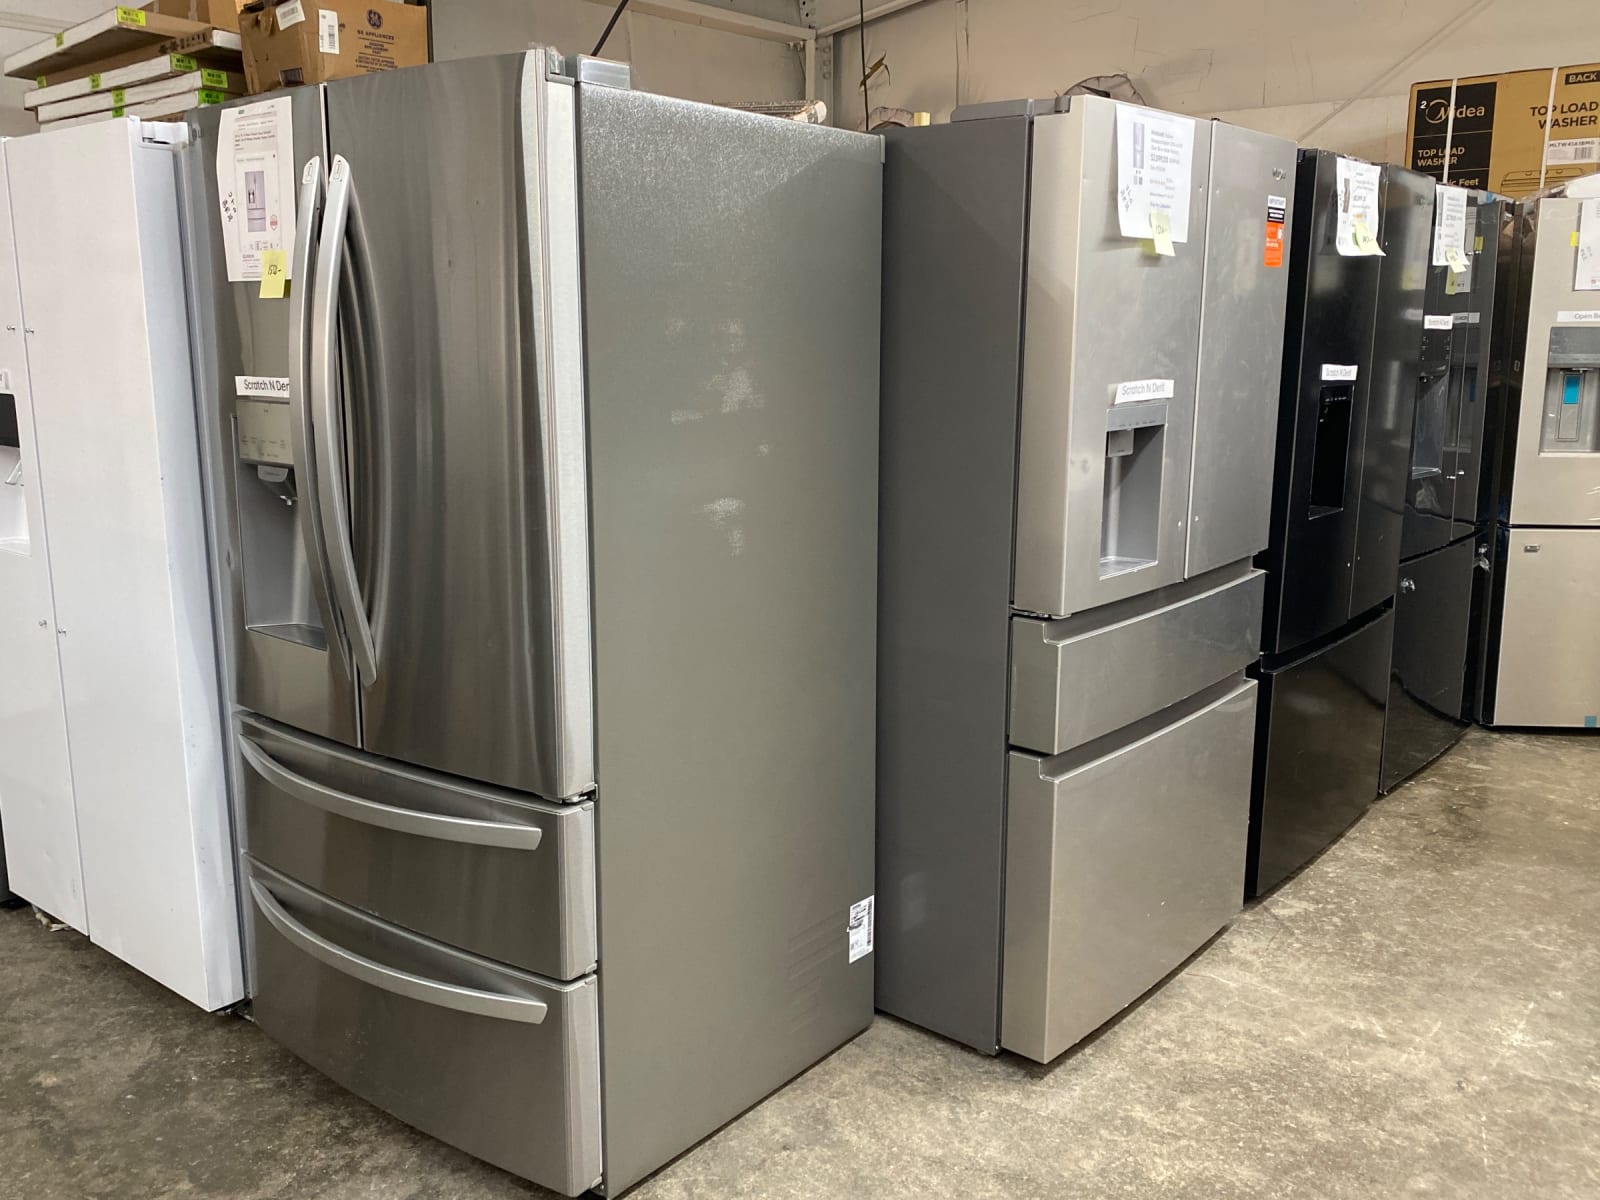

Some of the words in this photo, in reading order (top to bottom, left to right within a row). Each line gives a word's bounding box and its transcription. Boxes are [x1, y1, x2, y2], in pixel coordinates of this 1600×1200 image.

[1568, 72, 1598, 83] BACK
[1420, 100, 1427, 109] 2
[1560, 101, 1599, 115] LOAD
[1425, 99, 1485, 124] Mdea
[1418, 149, 1437, 158] TOP
[1574, 312, 1593, 320] Open
[243, 378, 269, 391] Scratch
[269, 379, 276, 391] N
[1121, 384, 1145, 396] Scratch
[1146, 383, 1152, 393] N
[1152, 382, 1165, 393] Dent
